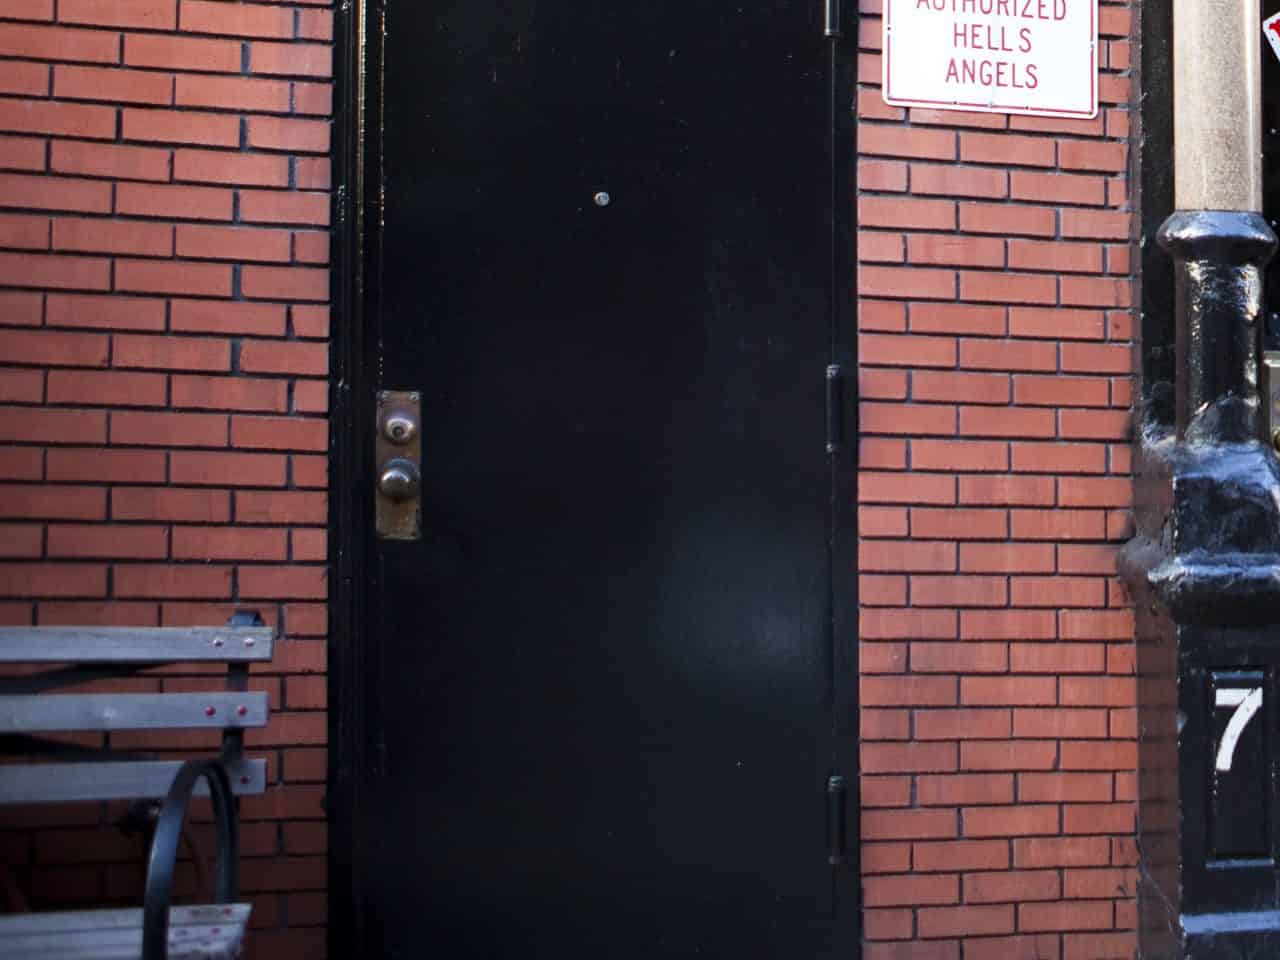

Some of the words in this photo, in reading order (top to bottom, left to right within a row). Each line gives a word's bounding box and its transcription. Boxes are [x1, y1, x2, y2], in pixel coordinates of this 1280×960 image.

[953, 23, 1033, 53] HELLS
[945, 58, 1039, 89] ANGELS
[1215, 687, 1264, 772] 7
